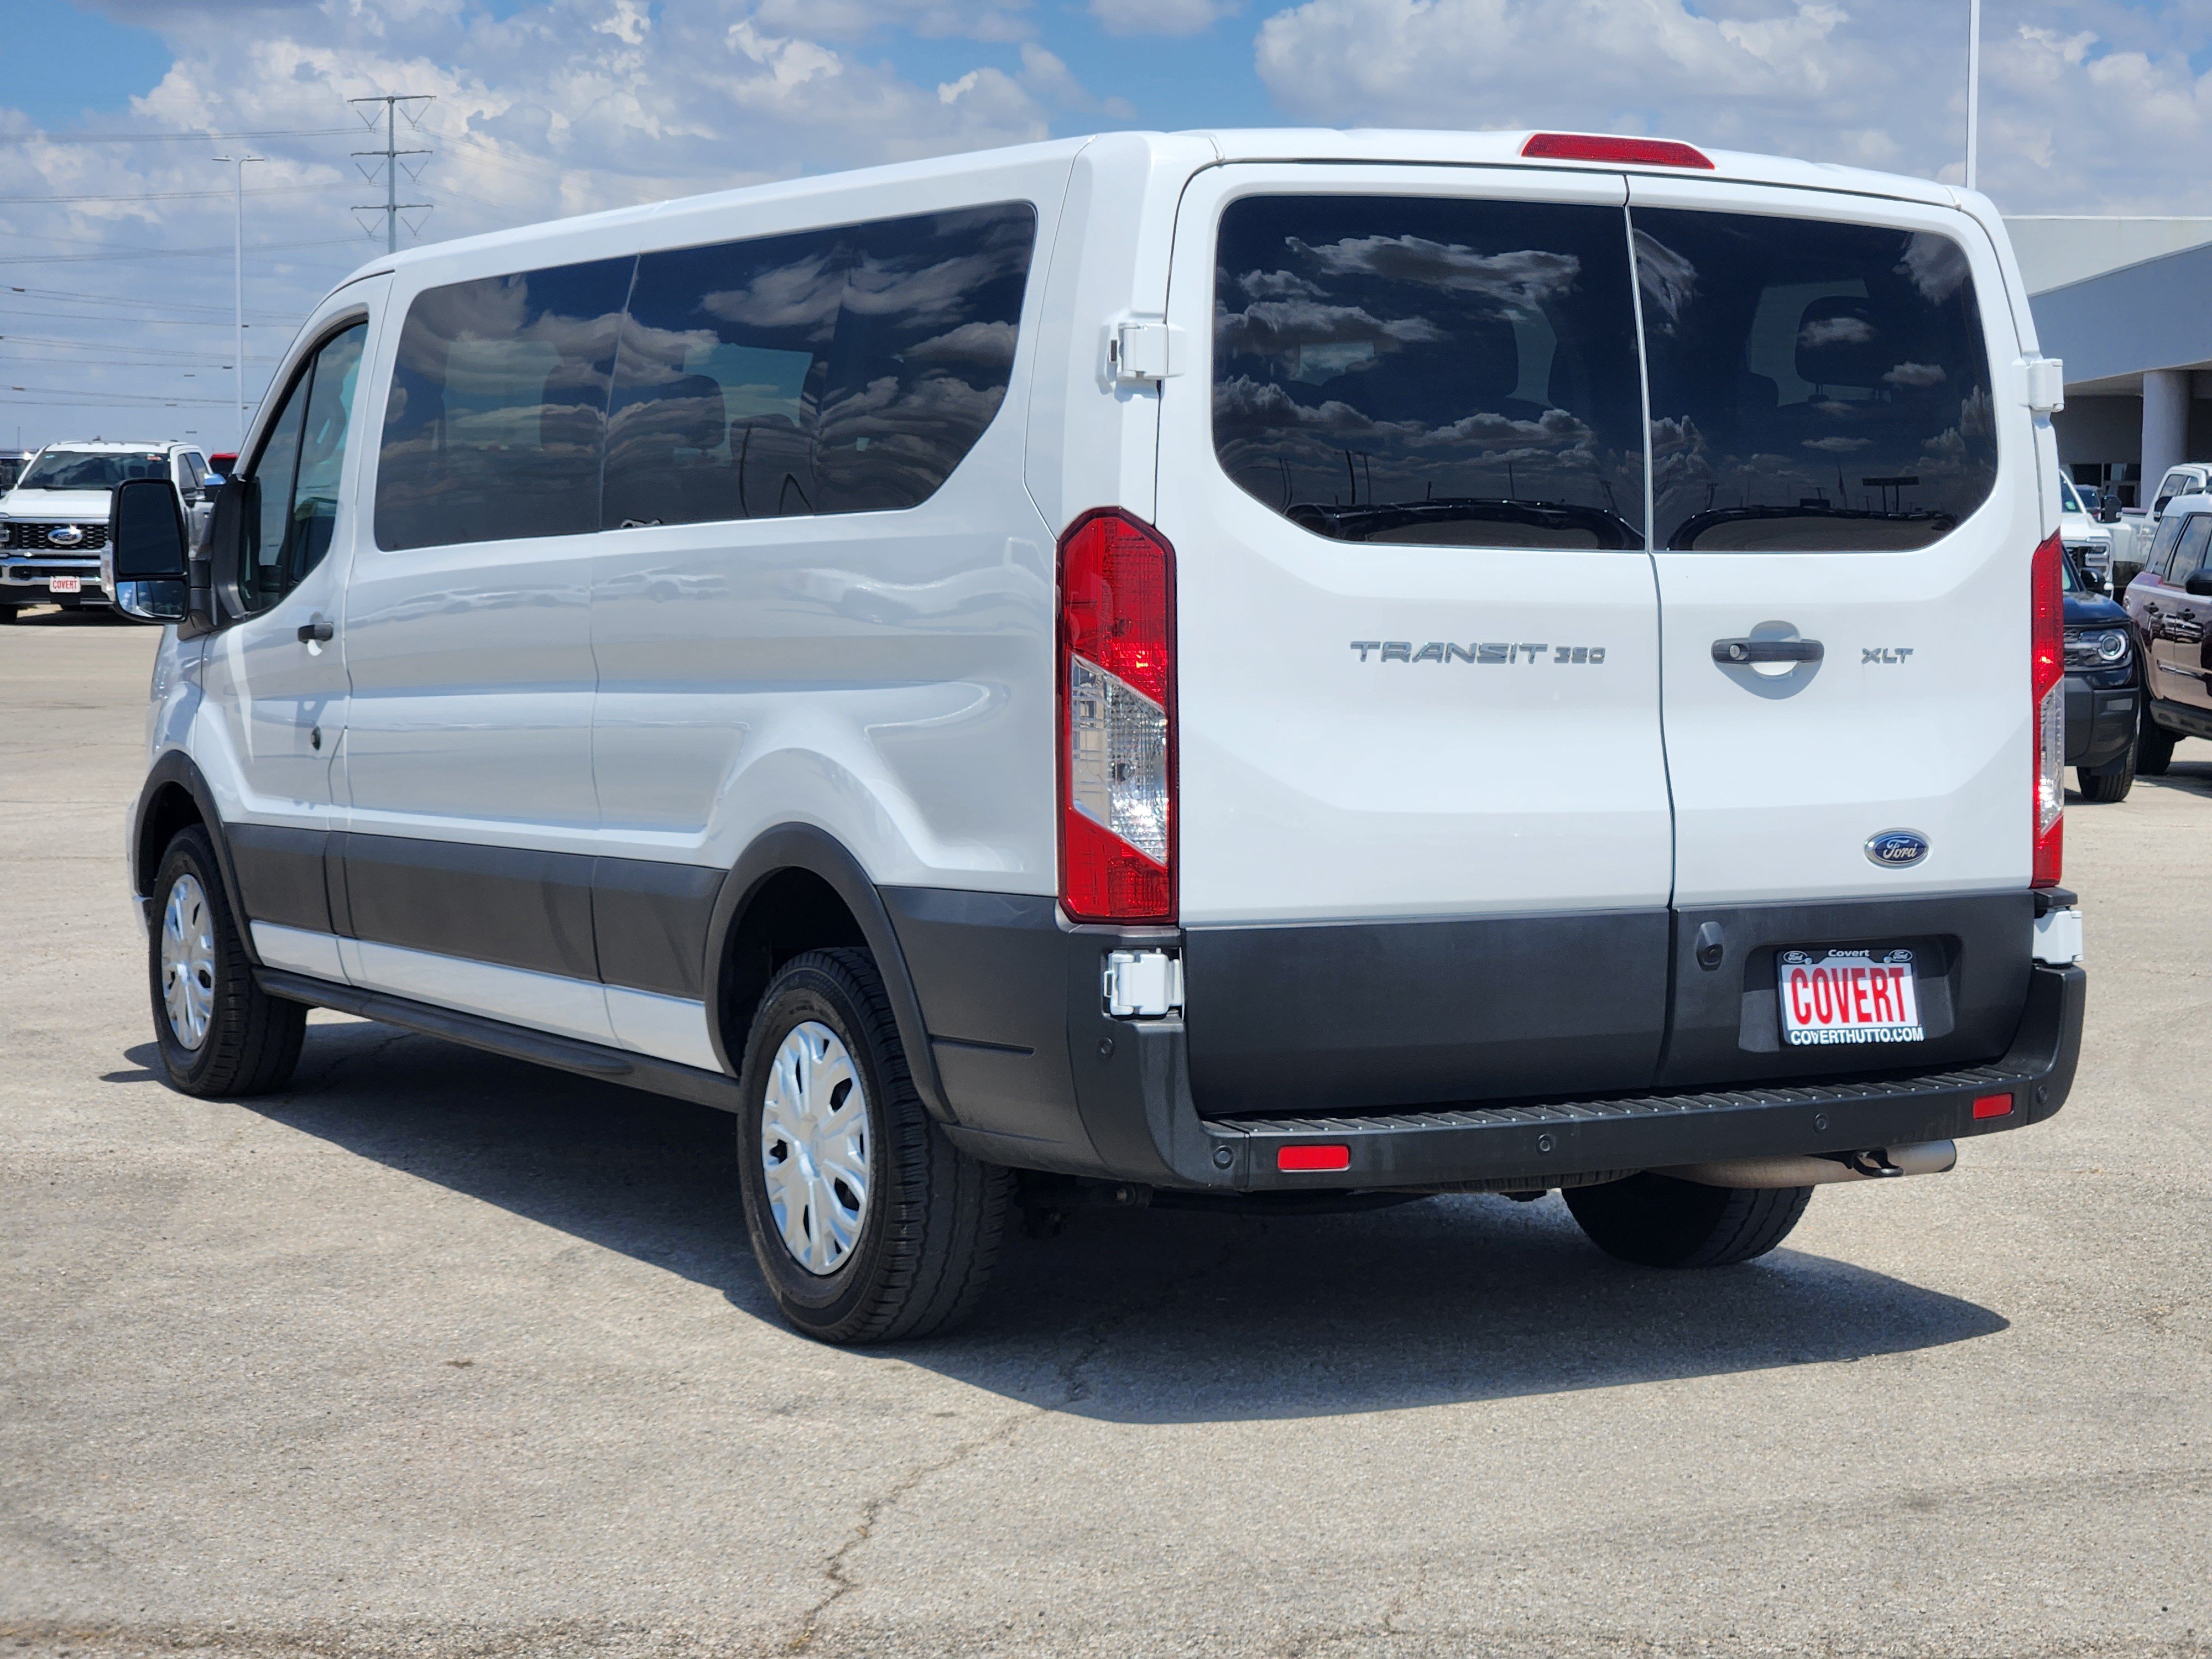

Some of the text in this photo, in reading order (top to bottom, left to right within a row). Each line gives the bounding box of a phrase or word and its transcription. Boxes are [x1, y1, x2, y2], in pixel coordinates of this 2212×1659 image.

[53, 580, 77, 589] COVERT
[1350, 641, 1605, 664] TRANSIT 350
[1861, 648, 1914, 664] XLT
[1883, 838, 1918, 859] Ford
[1790, 967, 1906, 1025] COVERT
[1791, 1027, 1924, 1045] COVERTHUTTO.COM
